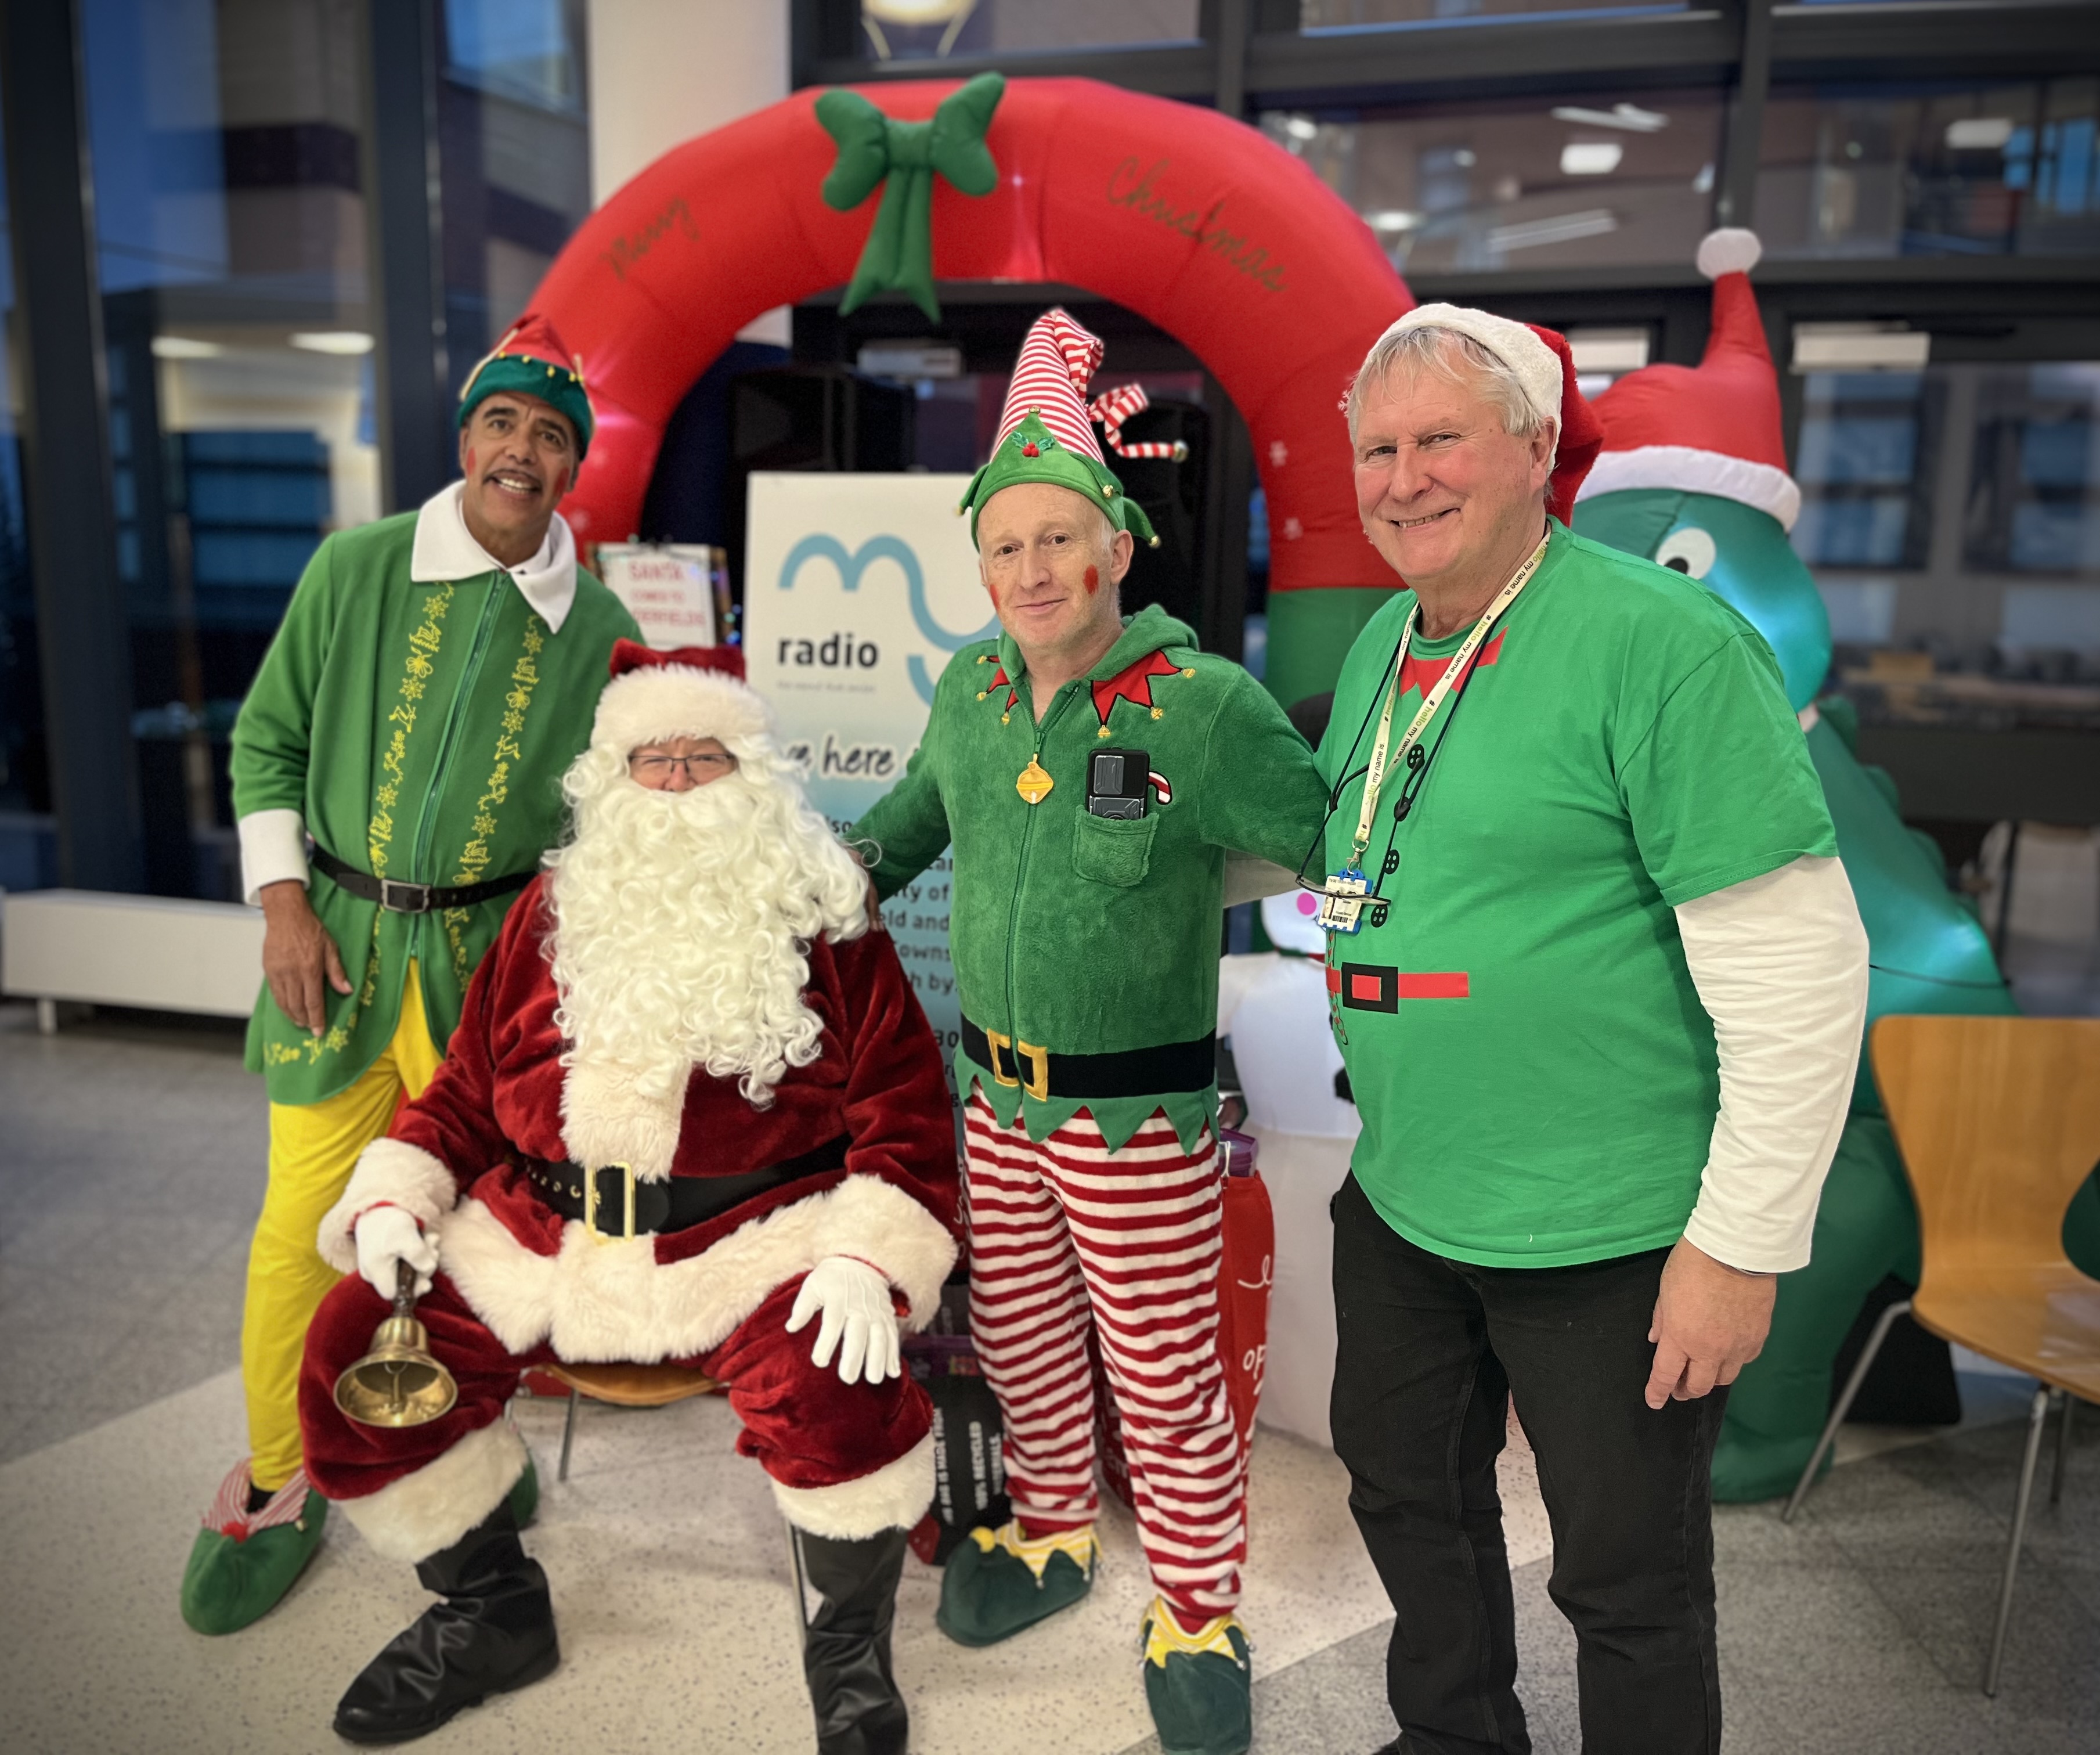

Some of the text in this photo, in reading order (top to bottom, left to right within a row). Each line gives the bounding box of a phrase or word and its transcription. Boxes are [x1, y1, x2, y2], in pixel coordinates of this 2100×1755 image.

[1524, 561, 1533, 572] my
[1510, 571, 1526, 589] name
[1471, 621, 1488, 641] hello
[778, 632, 879, 668] radio
[1463, 642, 1471, 653] my
[1450, 653, 1464, 672] name
[1416, 707, 1433, 726] hello
[1408, 727, 1417, 738] my
[822, 734, 894, 776] here
[1397, 738, 1410, 757] name
[1375, 751, 1383, 771] name
[1372, 773, 1380, 783] my
[928, 883, 950, 902] of
[912, 913, 950, 932] and
[893, 940, 951, 962] owns
